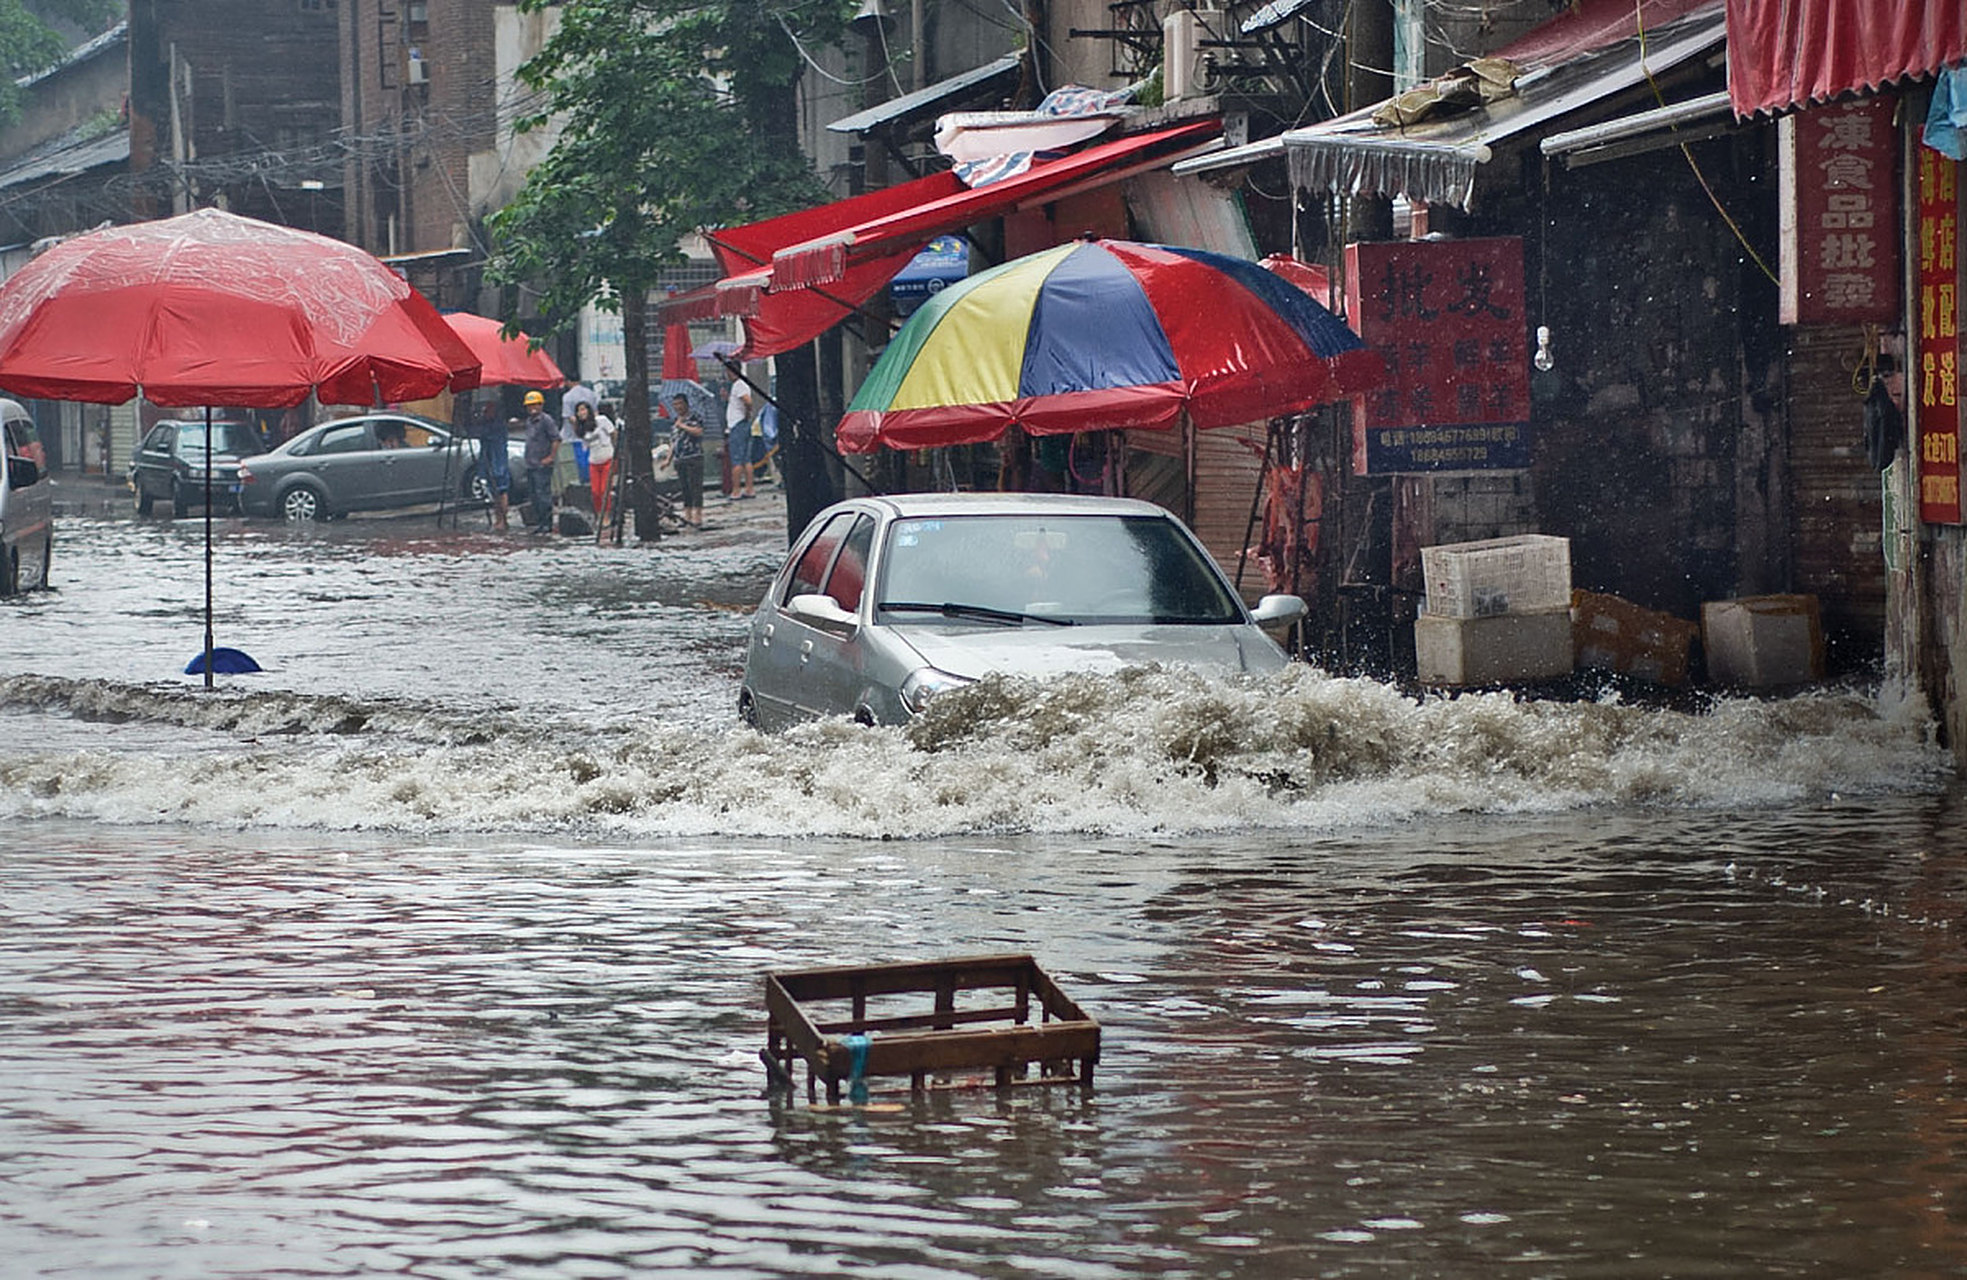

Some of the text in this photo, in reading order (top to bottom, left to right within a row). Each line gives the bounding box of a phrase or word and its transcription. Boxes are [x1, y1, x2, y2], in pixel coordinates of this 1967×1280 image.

[1818, 99, 1876, 308] 凍食品批發
